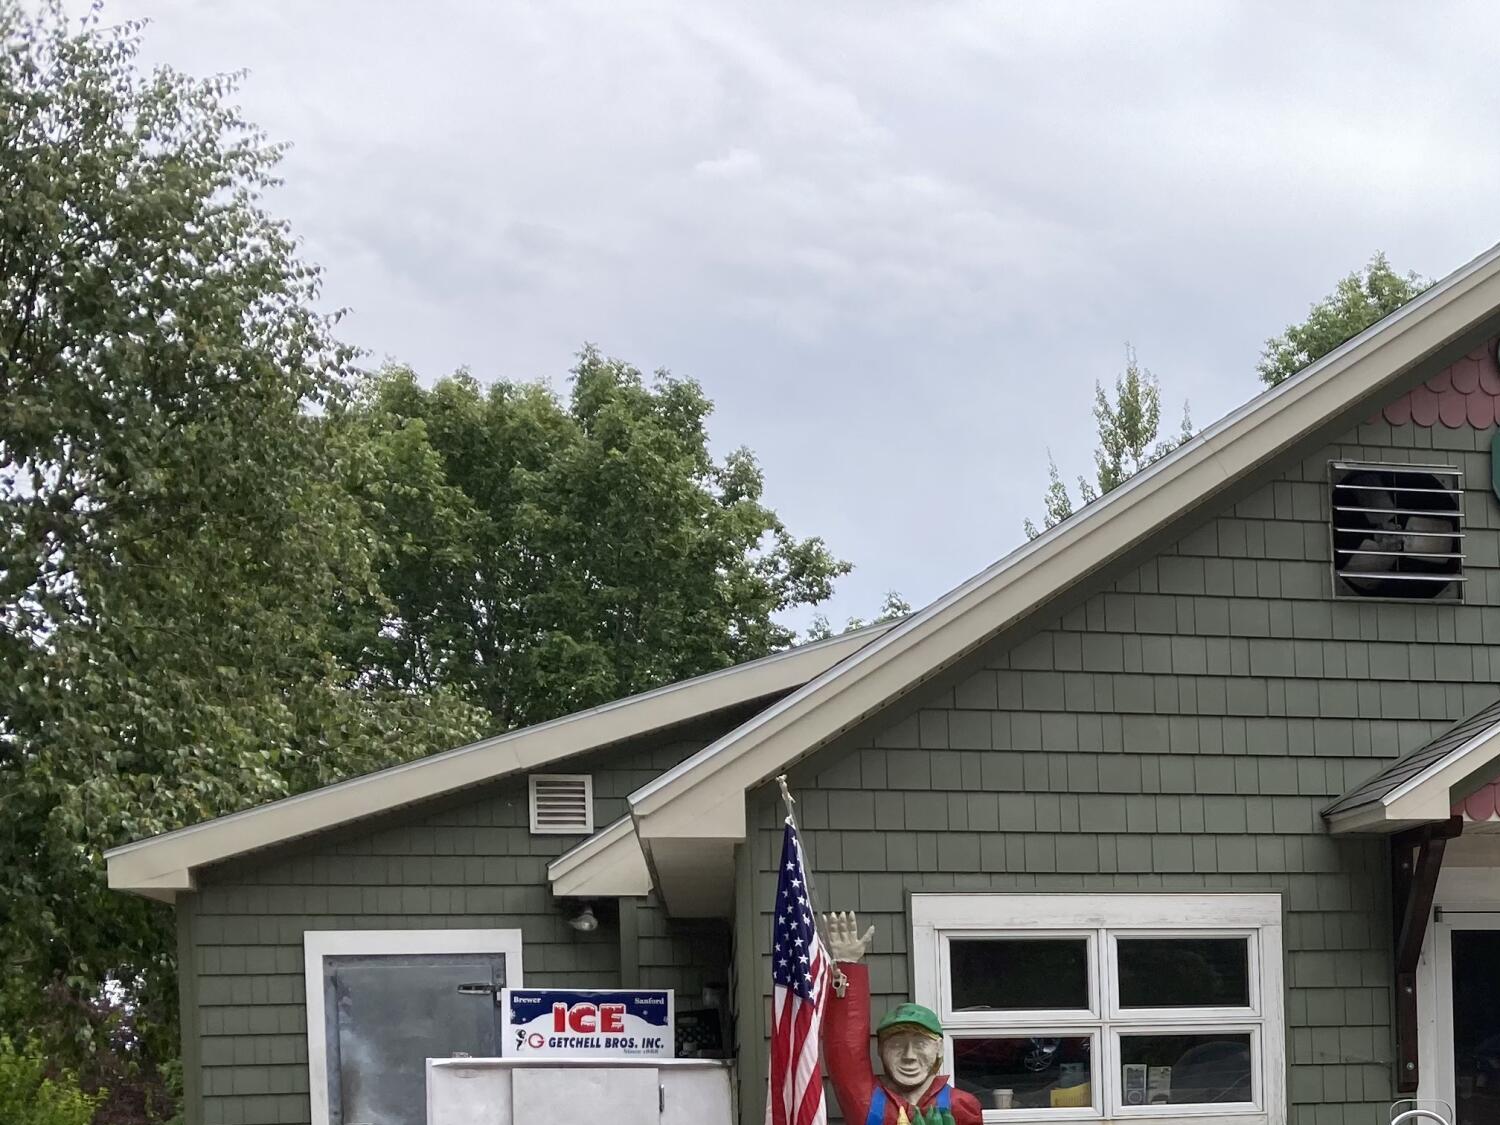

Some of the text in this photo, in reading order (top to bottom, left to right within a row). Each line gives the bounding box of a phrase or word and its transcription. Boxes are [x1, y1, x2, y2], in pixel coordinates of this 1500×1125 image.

[513, 996, 541, 1004] Brewer
[552, 1002, 626, 1034] ICE
[549, 1037, 601, 1049] GETCHELL
[605, 1038, 638, 1050] BROS.
[641, 1038, 665, 1050] INC.
